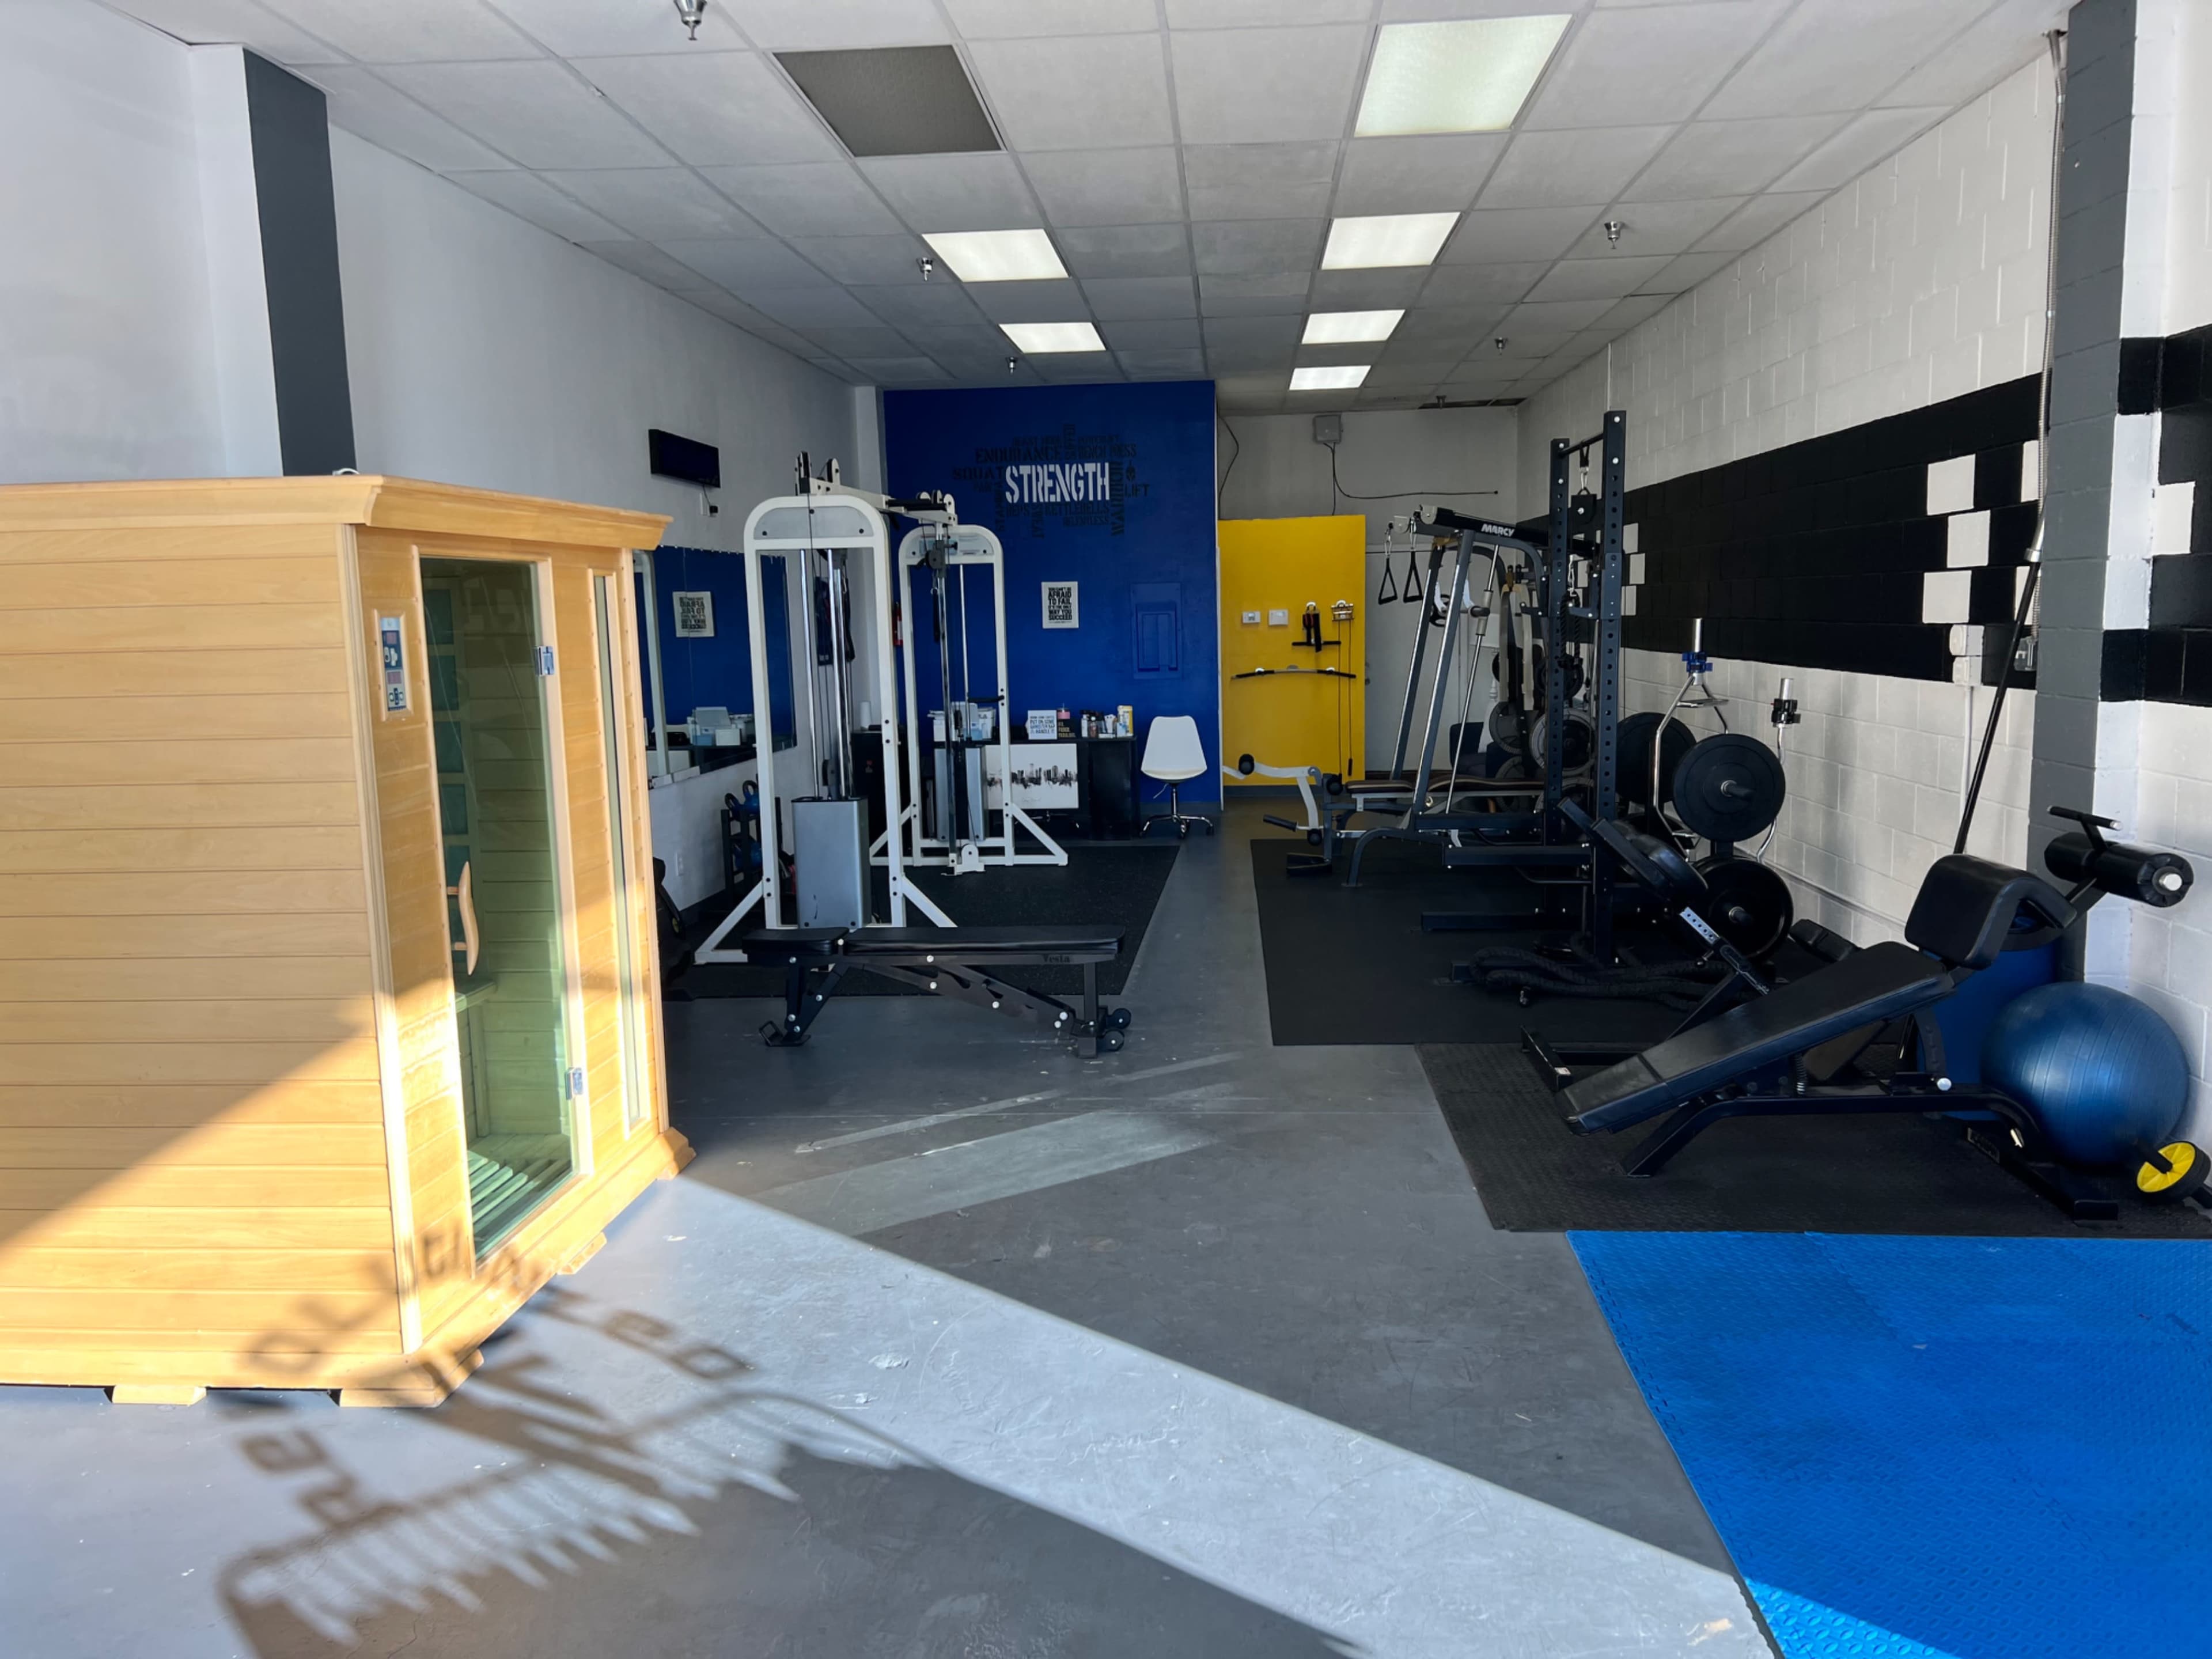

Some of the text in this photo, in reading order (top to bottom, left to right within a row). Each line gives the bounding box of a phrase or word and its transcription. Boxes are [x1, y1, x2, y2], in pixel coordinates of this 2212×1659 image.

[975, 446, 1061, 463] ENDURANCE
[953, 465, 1004, 480] SQUAT
[1005, 462, 1110, 503] STRENGTH
[1124, 484, 1150, 498] LIFT
[1481, 524, 1515, 537] MARCY
[1041, 954, 1070, 963] Vesta
